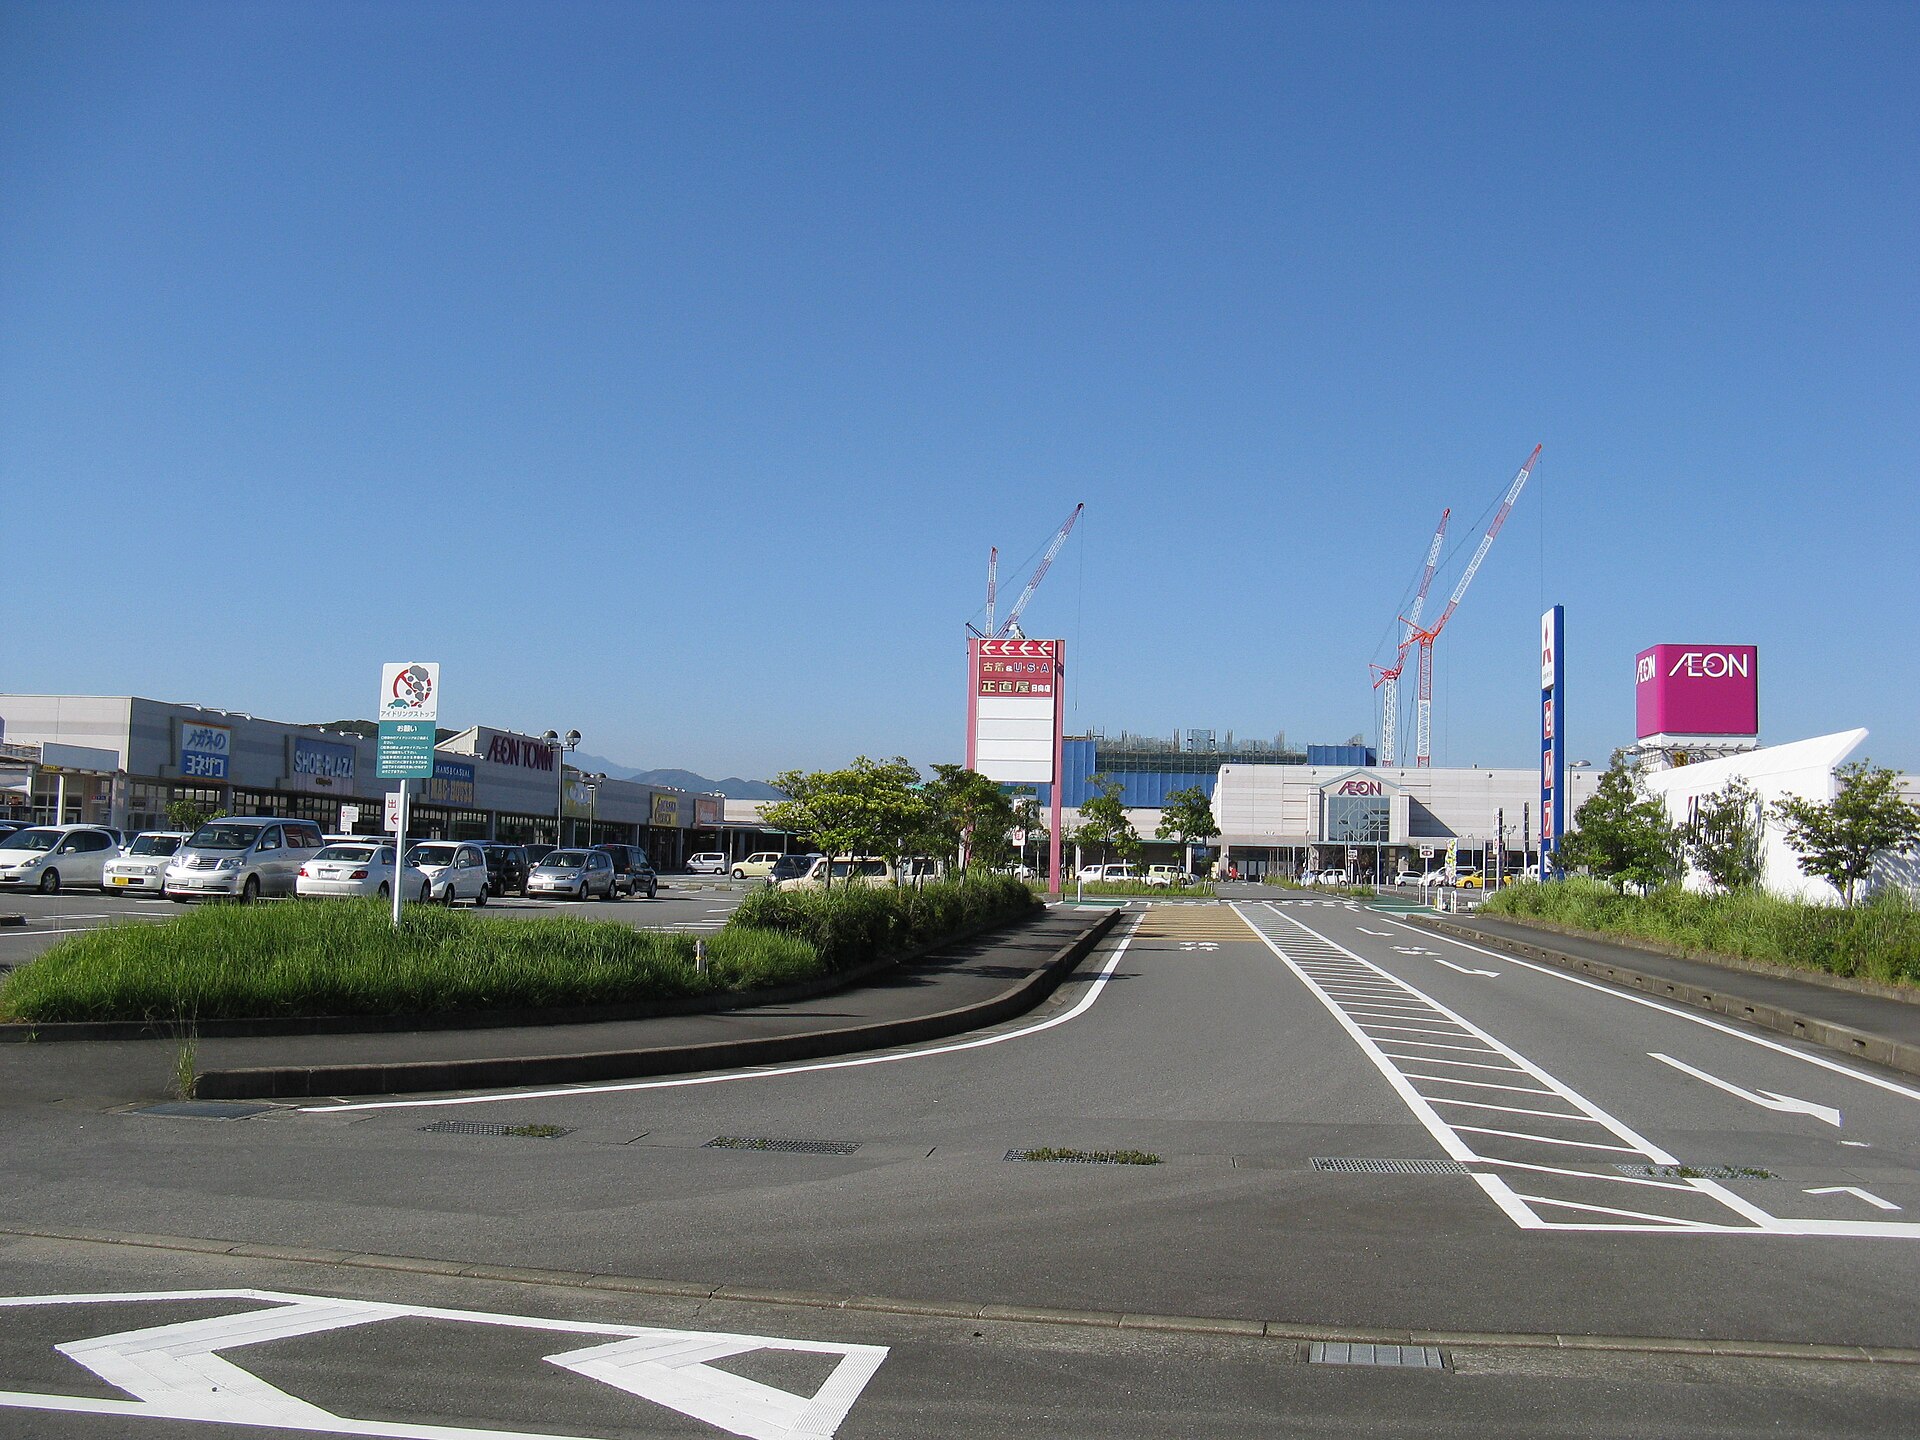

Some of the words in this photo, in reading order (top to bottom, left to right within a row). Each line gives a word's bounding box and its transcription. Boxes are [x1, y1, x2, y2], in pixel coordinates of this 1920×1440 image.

[187, 729, 226, 750] メガネの
[522, 741, 553, 772] TOWN
